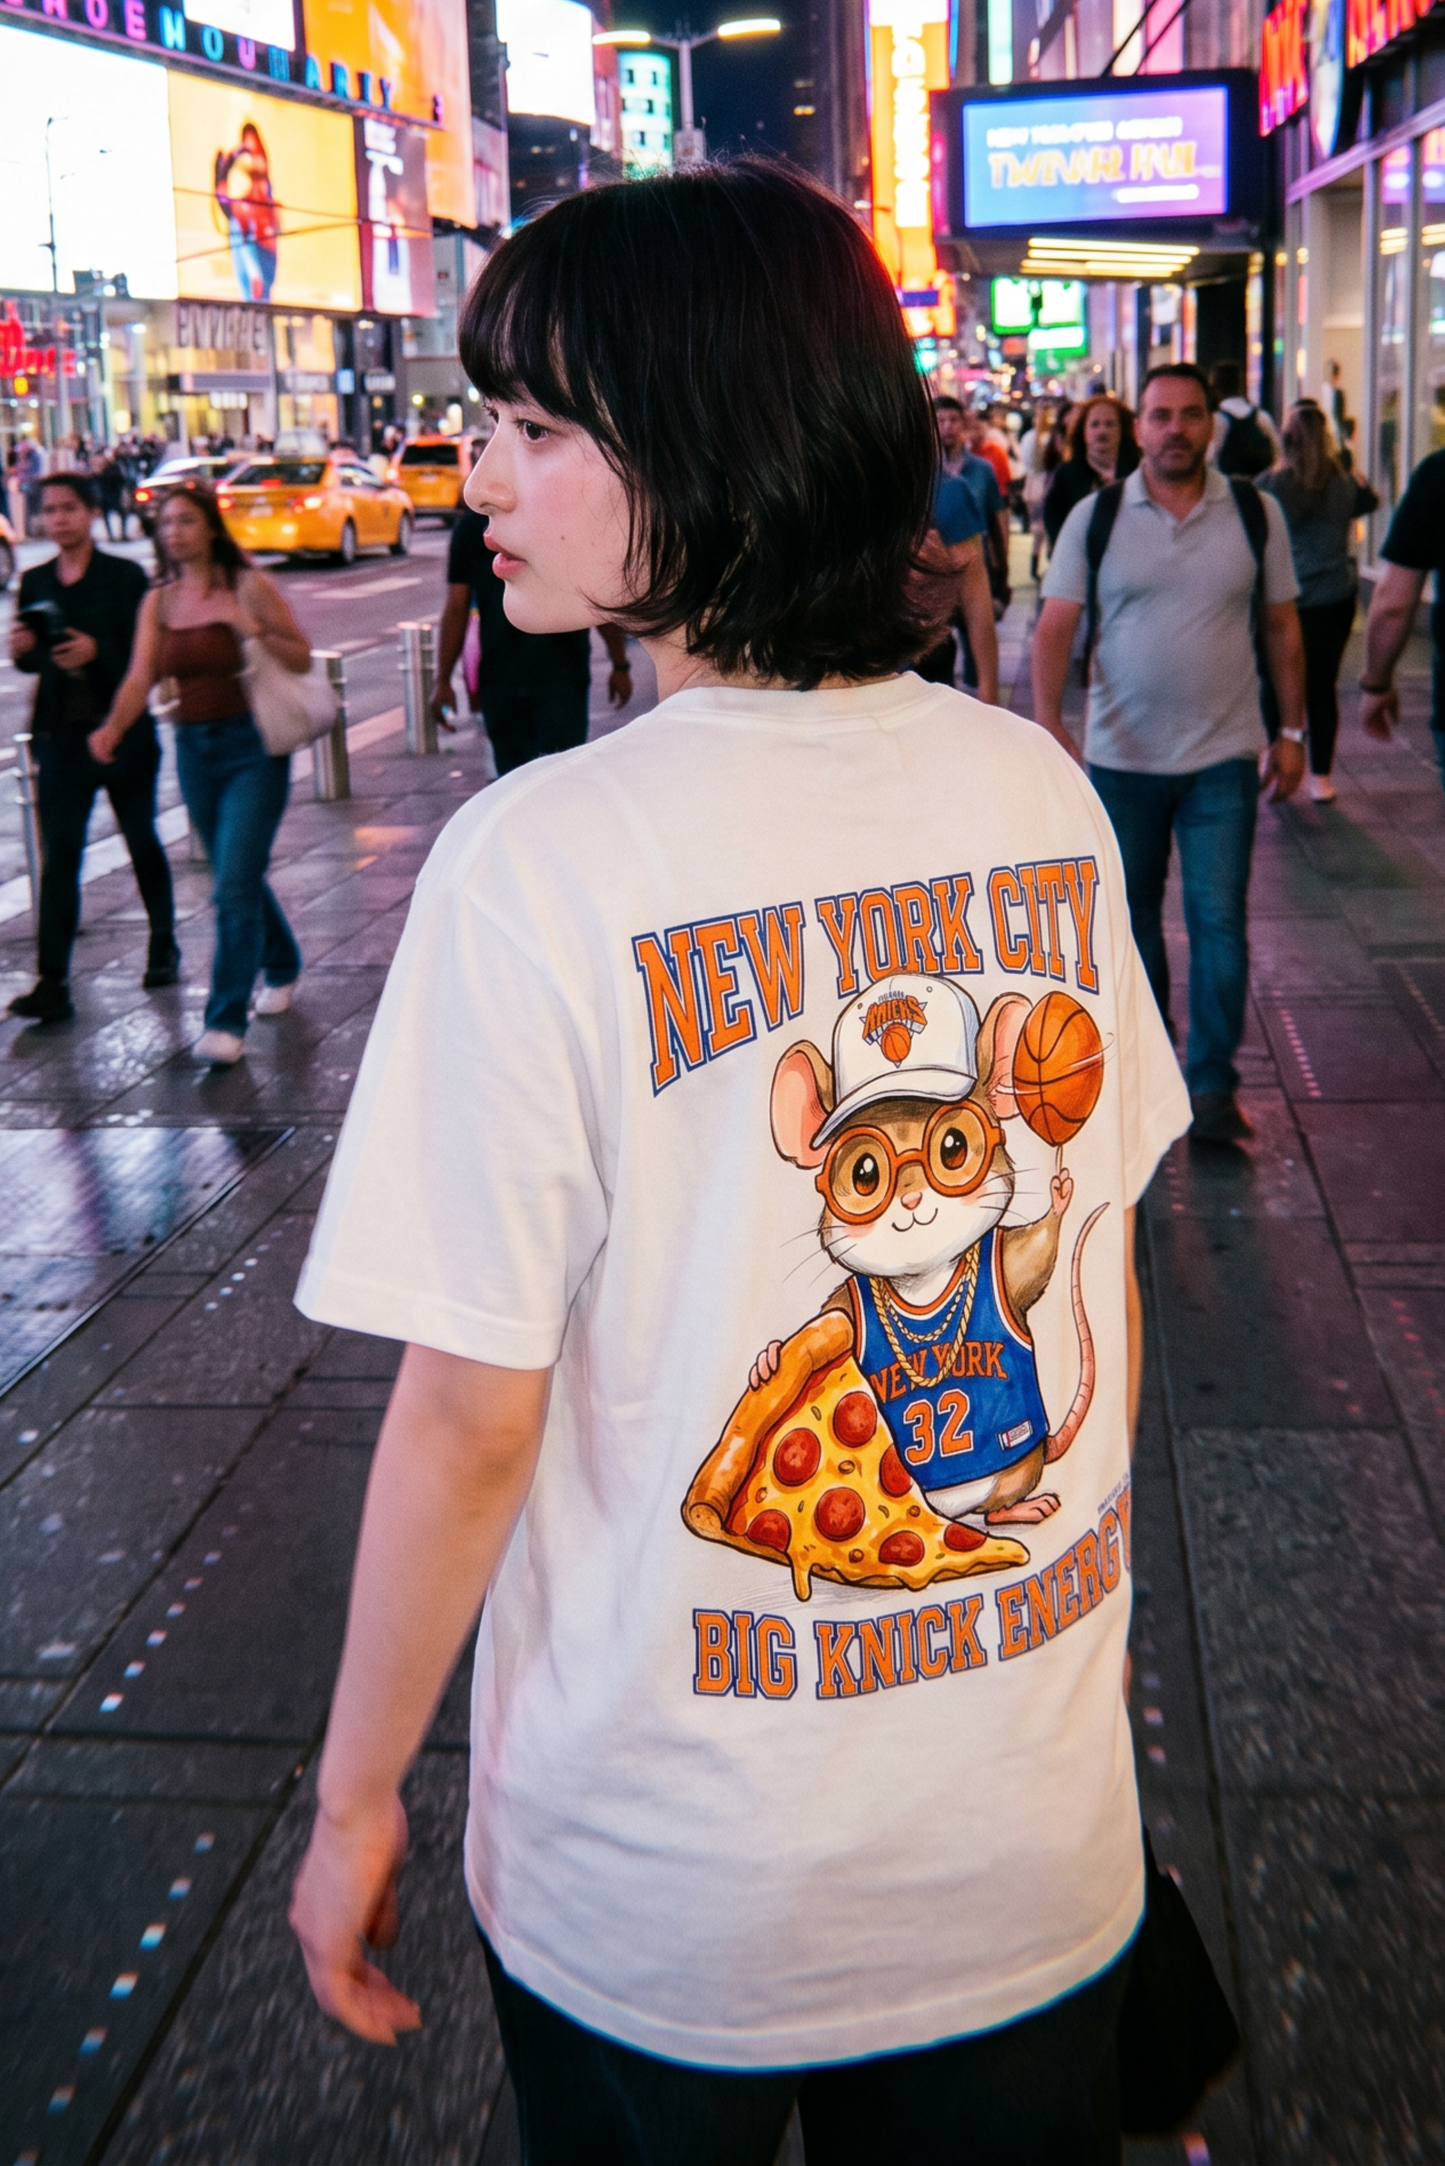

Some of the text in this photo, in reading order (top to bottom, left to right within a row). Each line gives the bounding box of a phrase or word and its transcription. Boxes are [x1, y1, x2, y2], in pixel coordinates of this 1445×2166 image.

[631, 855, 1100, 1097] NEW YORK CITY
[931, 1341, 1009, 1380] YORK
[903, 1388, 974, 1466] 32
[693, 1608, 798, 1700] BIG
[813, 1594, 987, 1699] KNICK
